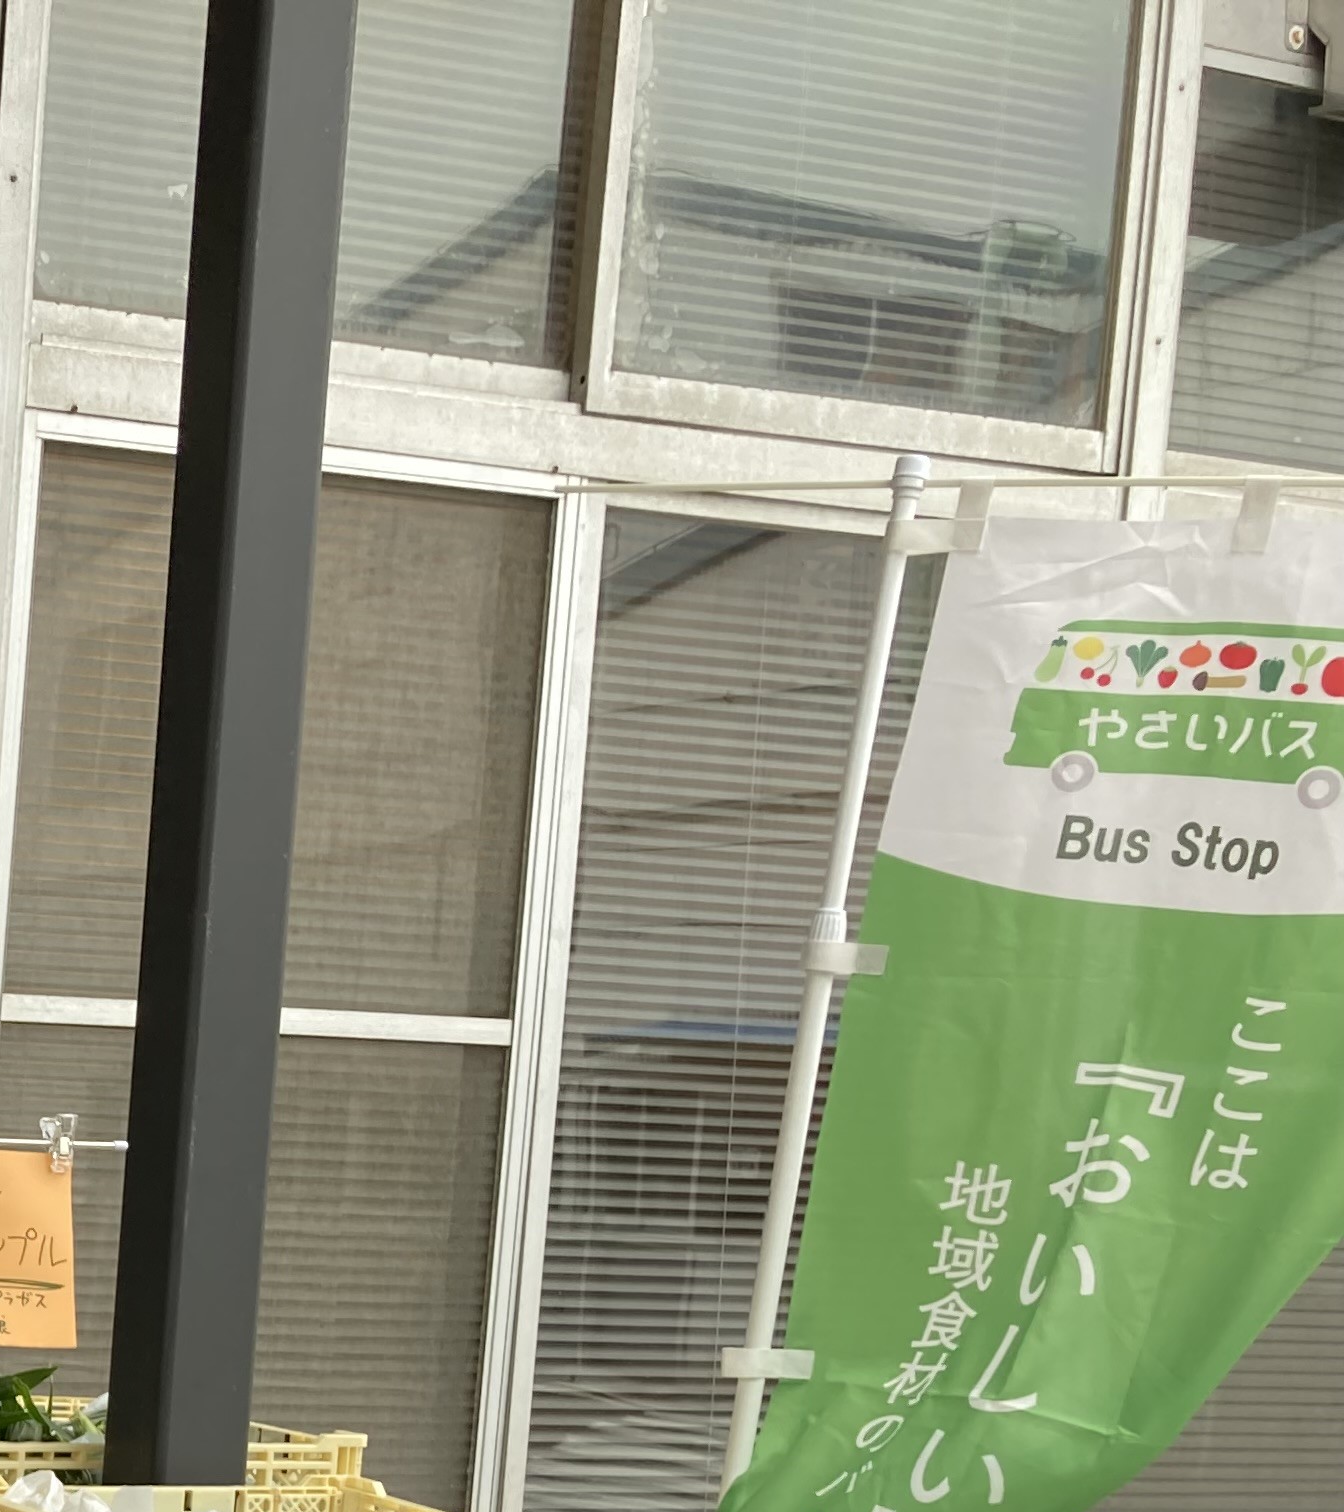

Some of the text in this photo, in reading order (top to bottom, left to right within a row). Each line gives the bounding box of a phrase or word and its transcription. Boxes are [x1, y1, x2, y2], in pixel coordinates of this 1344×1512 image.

[1079, 707, 1318, 760] やさいバス
[1056, 815, 1279, 880] Bus Stop
[1189, 996, 1286, 1190] ここは
